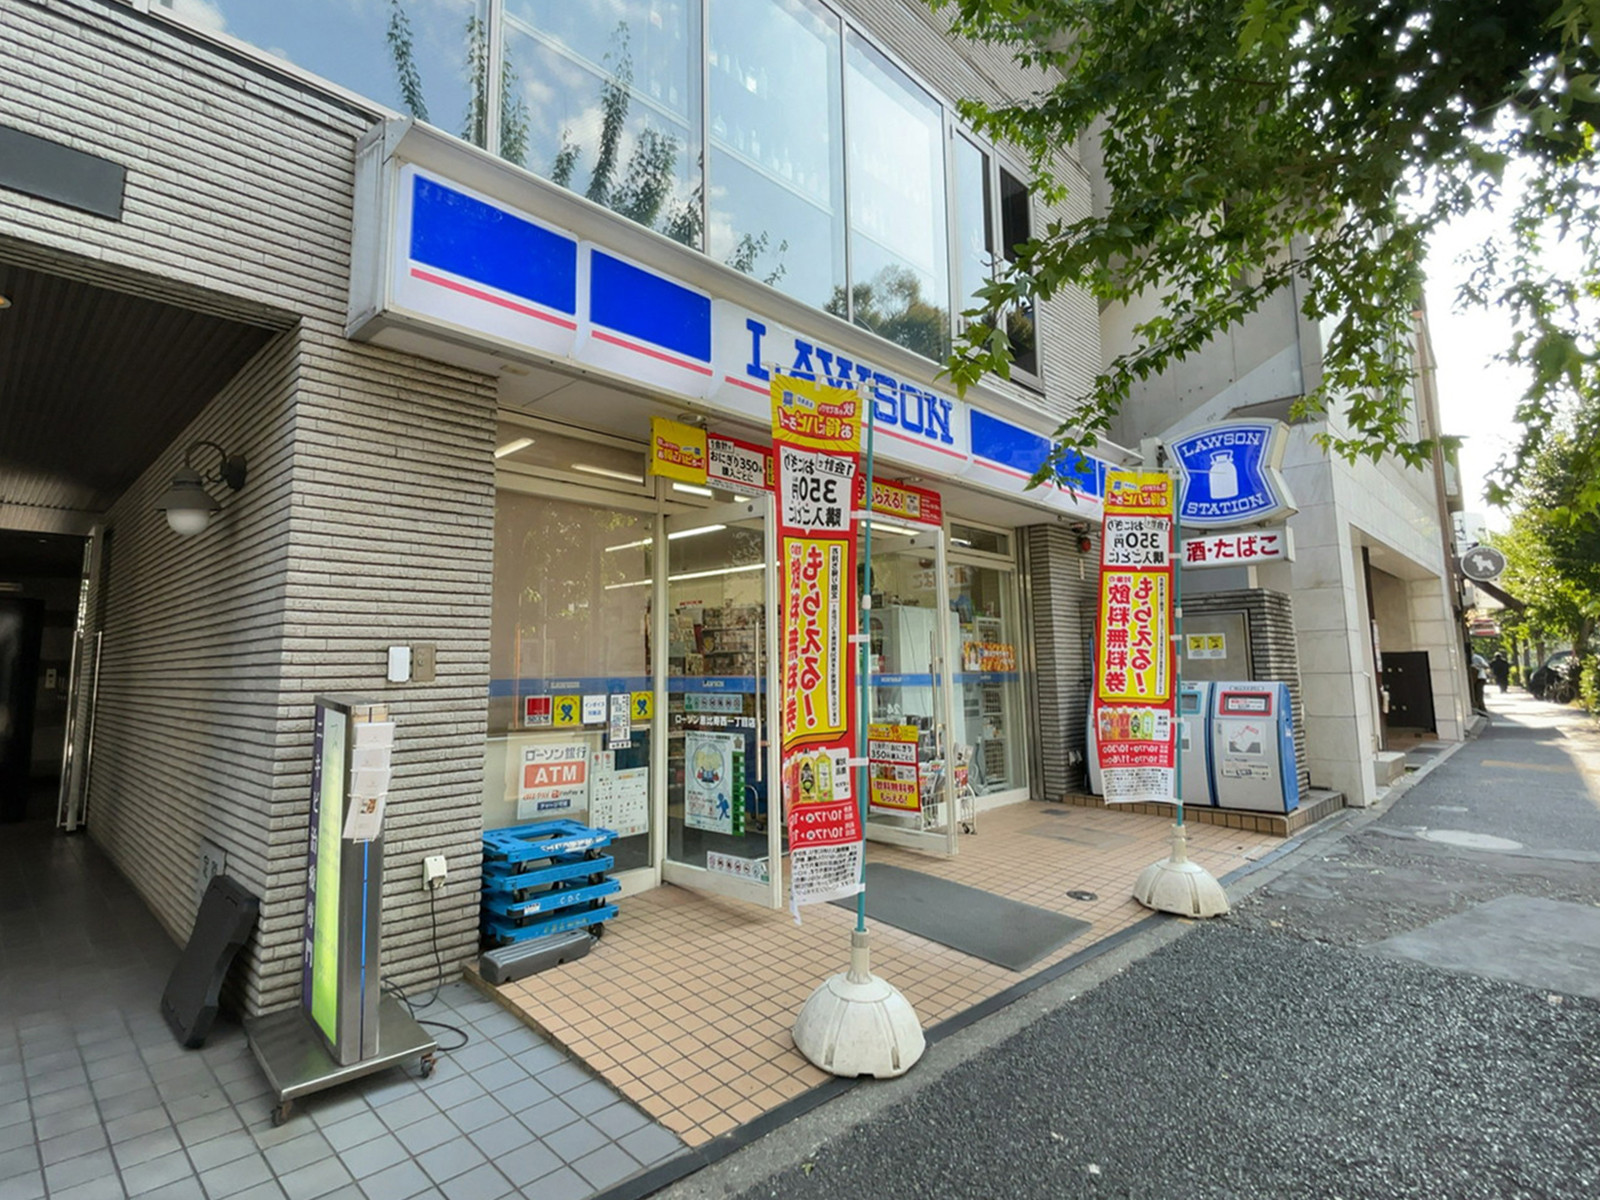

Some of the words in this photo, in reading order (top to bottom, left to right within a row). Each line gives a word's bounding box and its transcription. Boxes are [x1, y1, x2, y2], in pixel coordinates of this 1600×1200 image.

[746, 318, 954, 445] LAWSON
[1181, 432, 1262, 458] LAWSON
[1187, 493, 1266, 515] STATION
[1186, 534, 1279, 562] 酒・たばこ
[525, 746, 587, 761] ローソン銀行
[534, 764, 577, 785] ATM
